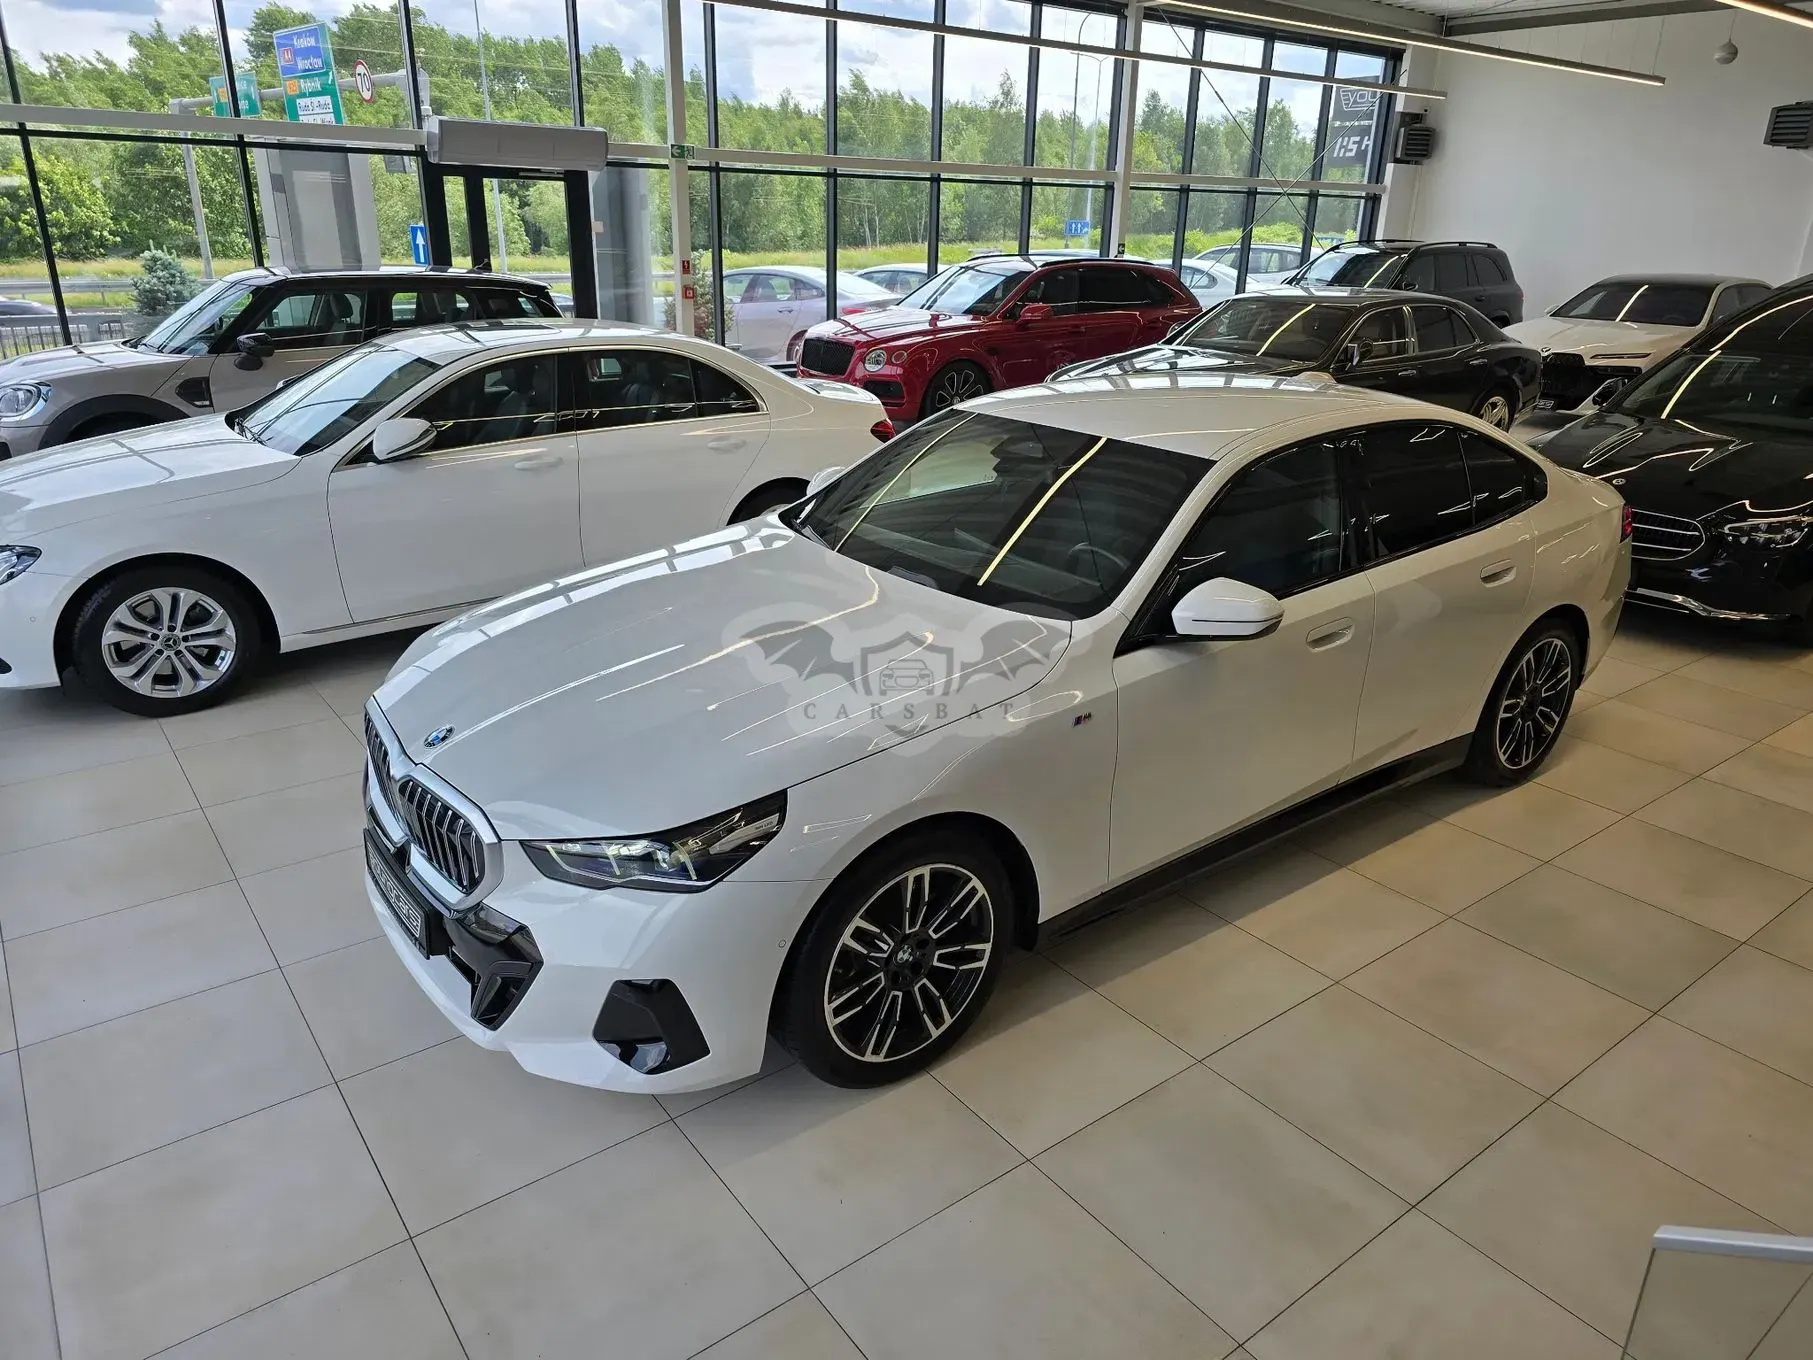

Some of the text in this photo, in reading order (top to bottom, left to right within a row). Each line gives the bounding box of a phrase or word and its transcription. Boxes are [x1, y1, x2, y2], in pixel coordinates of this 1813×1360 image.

[293, 33, 316, 49] Kraków
[296, 55, 323, 70] Wrocław
[300, 77, 322, 96] Rybnik
[357, 72, 371, 92] 70
